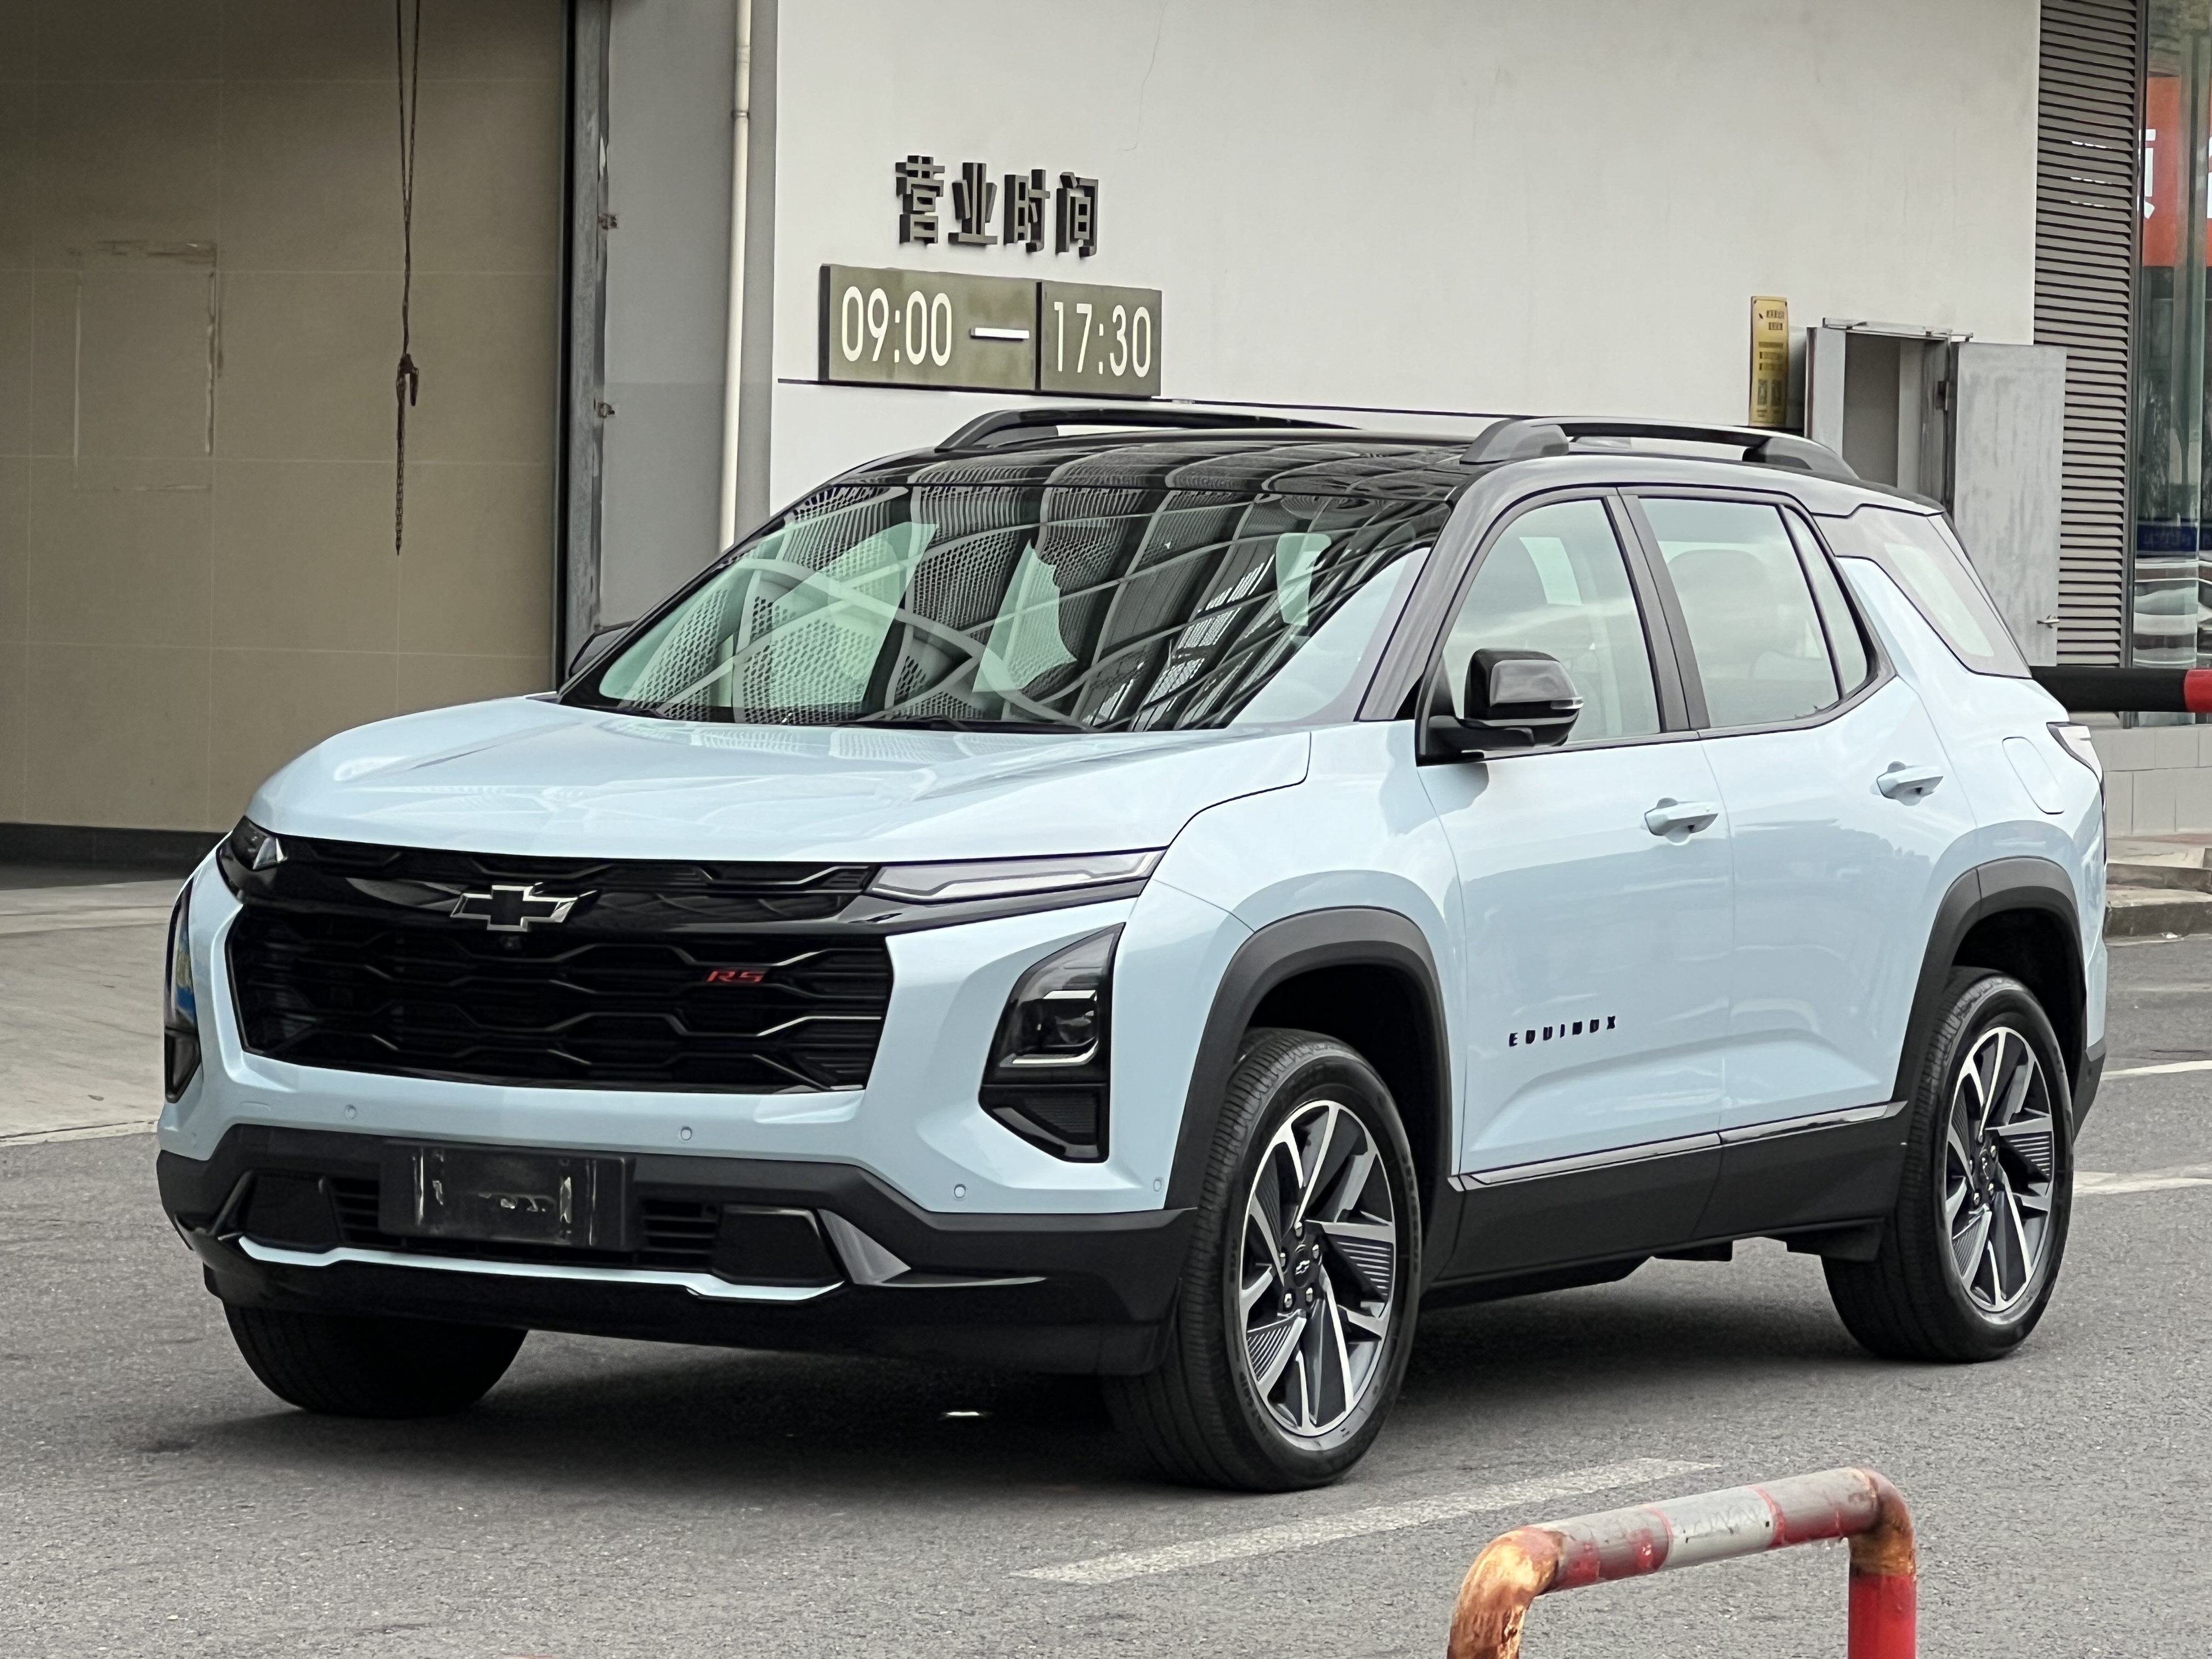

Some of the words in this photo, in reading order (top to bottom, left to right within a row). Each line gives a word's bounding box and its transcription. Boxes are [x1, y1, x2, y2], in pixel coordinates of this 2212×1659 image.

[895, 155, 1099, 257] 营业时间
[841, 285, 952, 366] 09:00
[1053, 301, 1151, 377] 17:30
[707, 970, 766, 983] RS
